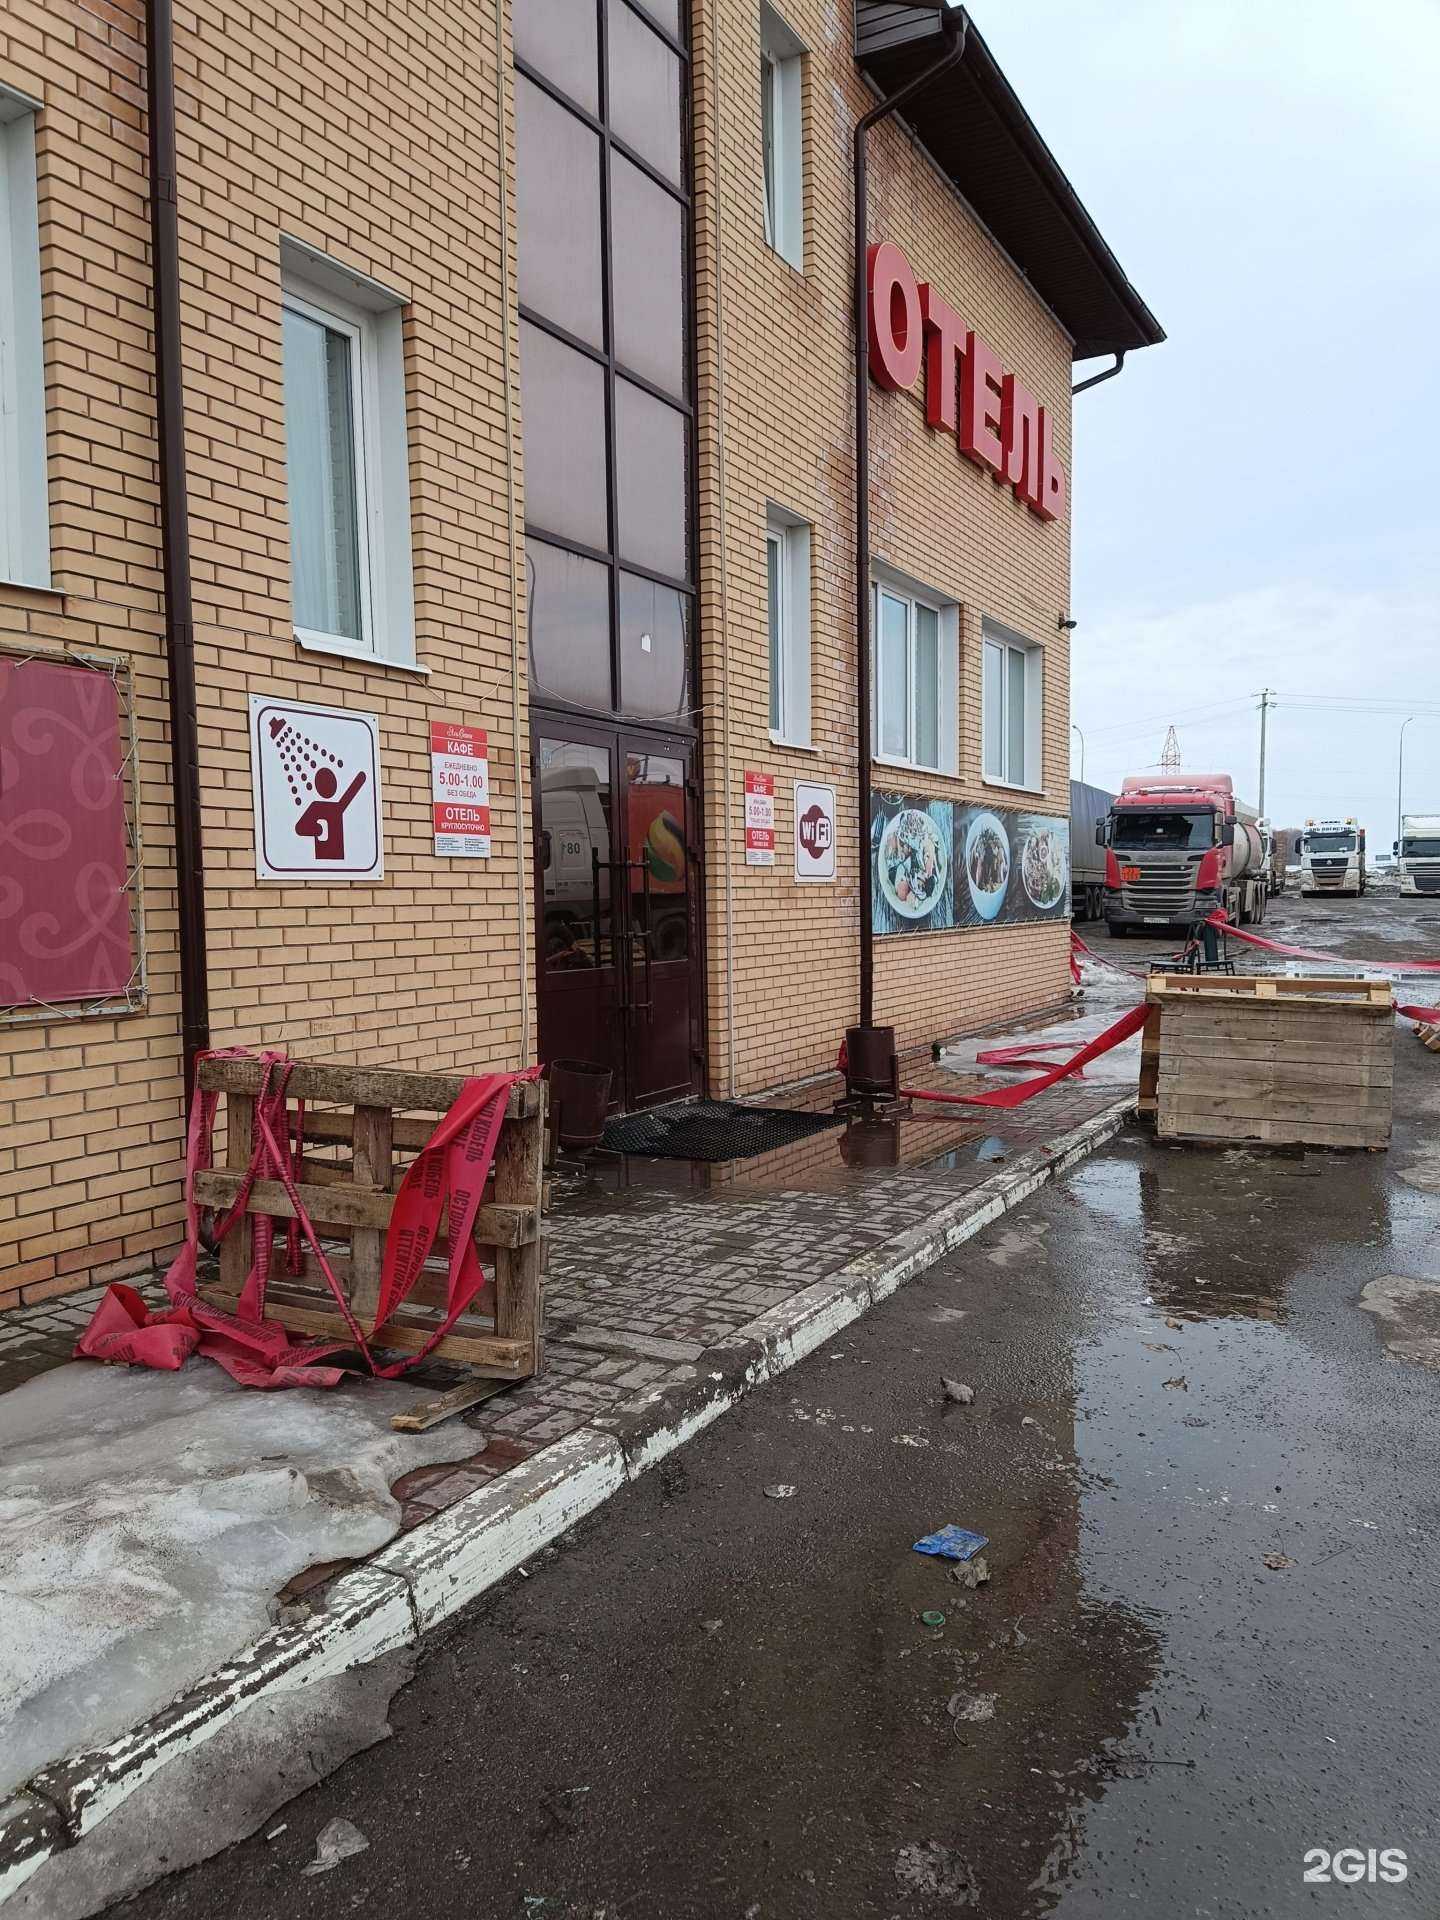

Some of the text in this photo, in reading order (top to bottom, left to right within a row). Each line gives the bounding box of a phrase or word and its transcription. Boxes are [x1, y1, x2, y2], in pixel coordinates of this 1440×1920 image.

[867, 241, 1066, 522] ОТЕЛЬ
[447, 740, 474, 755] КАФЕ
[444, 761, 478, 772] ЕЖЕДНЕВНО
[439, 772, 483, 789] 5.00-1.00
[446, 807, 480, 822] ОТЕЛЬ
